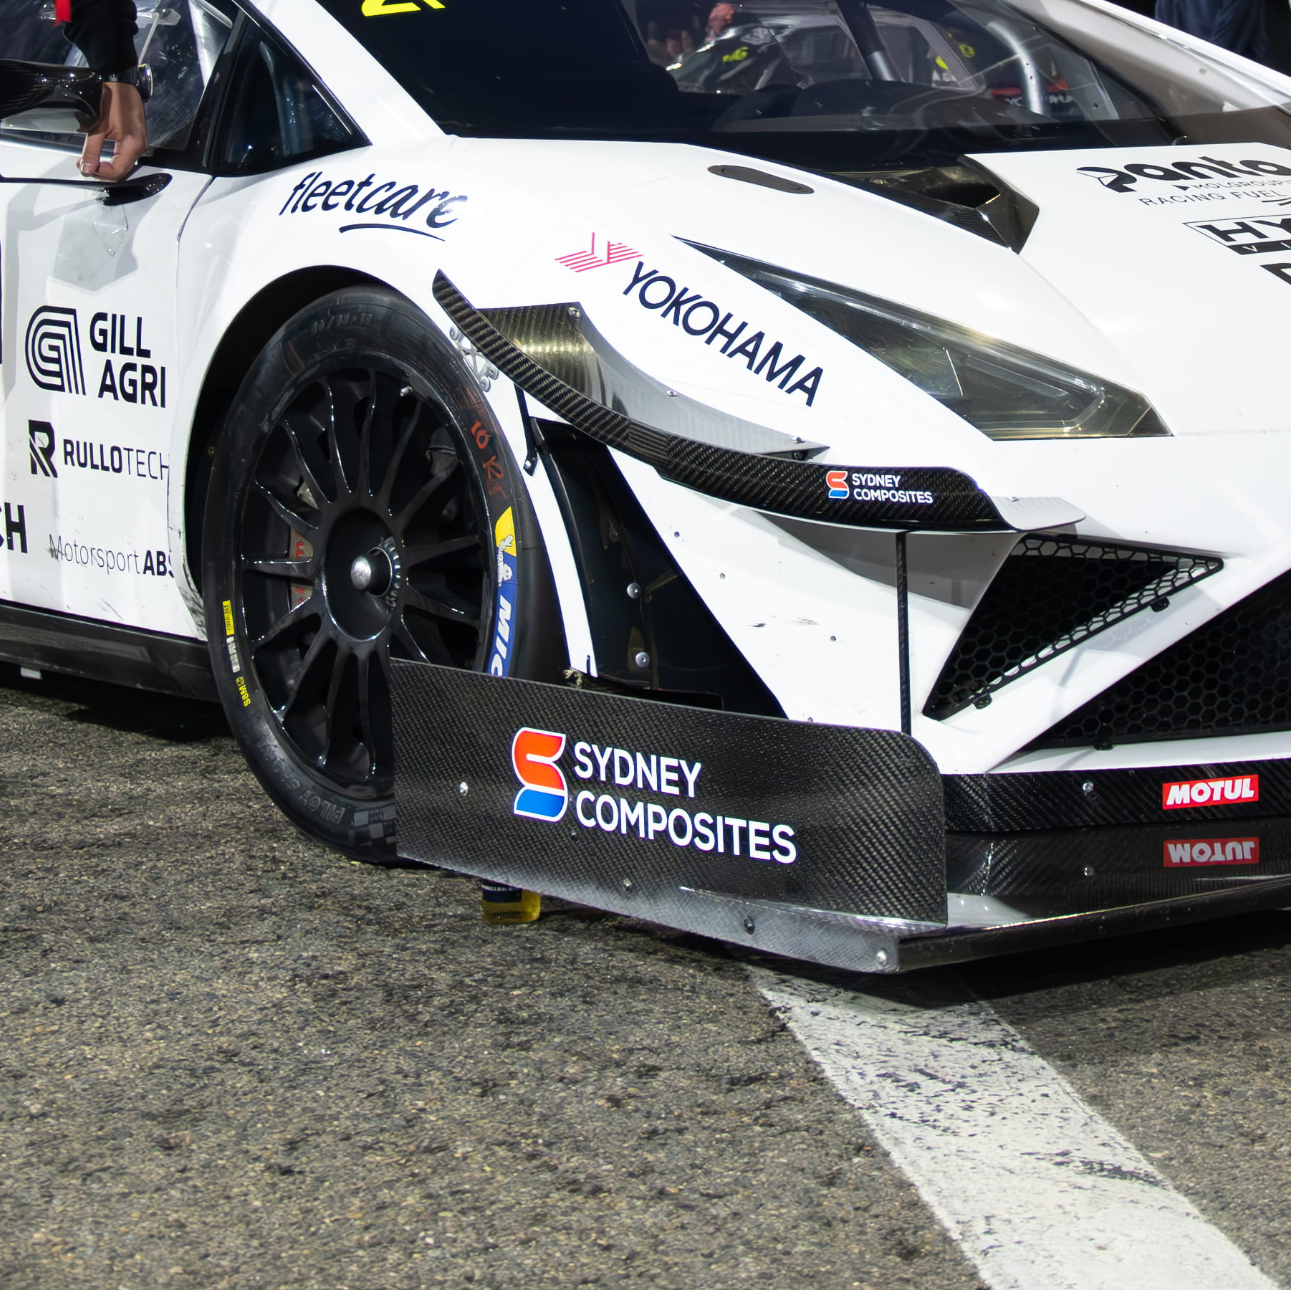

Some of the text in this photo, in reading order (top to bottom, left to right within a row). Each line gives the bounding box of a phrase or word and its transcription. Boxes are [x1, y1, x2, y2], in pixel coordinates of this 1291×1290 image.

[279, 171, 468, 229] fleetcare
[1138, 188, 1289, 207] RACING FUEL
[89, 312, 152, 359] GILL
[621, 260, 825, 409] YOKOHAMA
[98, 358, 166, 408] AGRI
[63, 438, 170, 480] RULLOTECH
[851, 473, 901, 488] SYDNEY
[852, 487, 934, 504] COMPOSITES
[49, 533, 140, 576] Motorsport
[574, 741, 702, 800] SYDNEY
[1165, 777, 1256, 804] MOTUL
[575, 791, 798, 865] COMPOSITES
